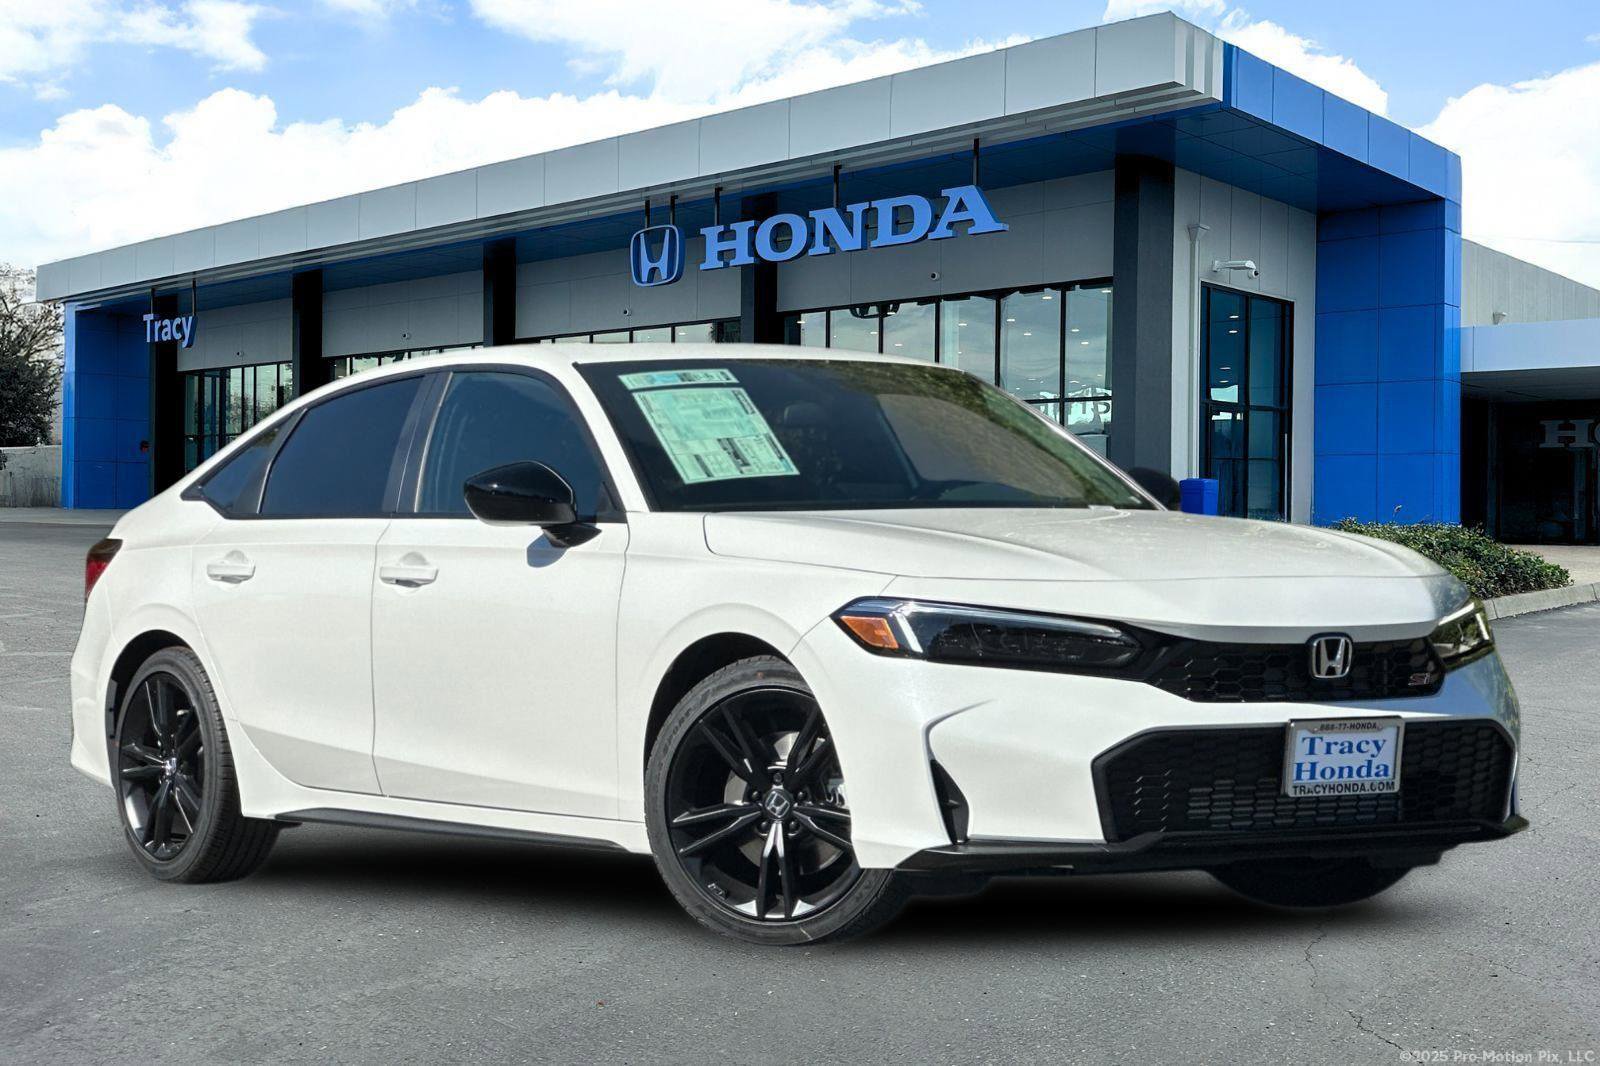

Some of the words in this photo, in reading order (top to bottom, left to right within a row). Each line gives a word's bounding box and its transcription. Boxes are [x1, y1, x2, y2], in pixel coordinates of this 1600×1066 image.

[699, 185, 1009, 271] HONDA
[142, 313, 195, 349] Tracy
[1538, 419, 1600, 449] H
[1301, 736, 1387, 758] Tracy
[1293, 759, 1390, 782] Honda
[1292, 781, 1396, 796] TRACYHONDA.COM
